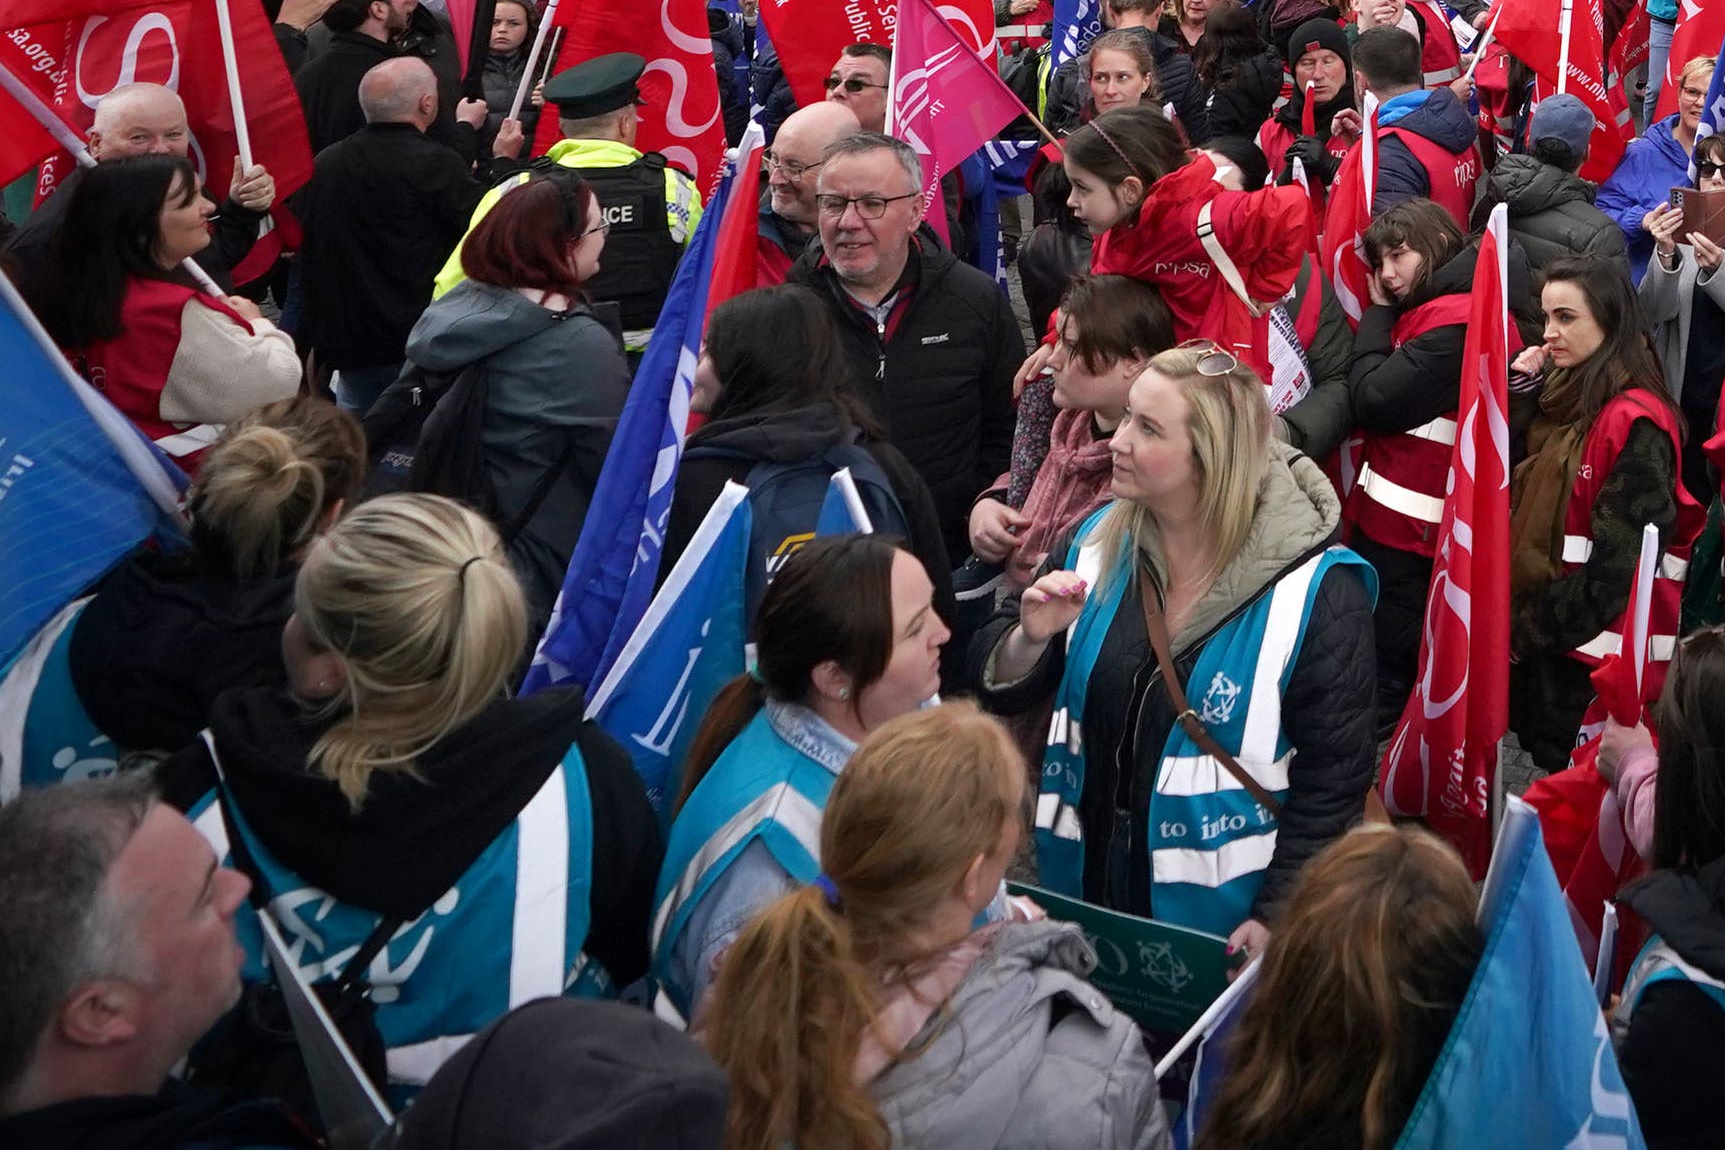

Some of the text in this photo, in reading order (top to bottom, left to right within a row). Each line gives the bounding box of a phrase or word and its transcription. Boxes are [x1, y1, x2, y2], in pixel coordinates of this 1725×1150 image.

[601, 205, 633, 224] ICE
[1159, 813, 1248, 841] to into
